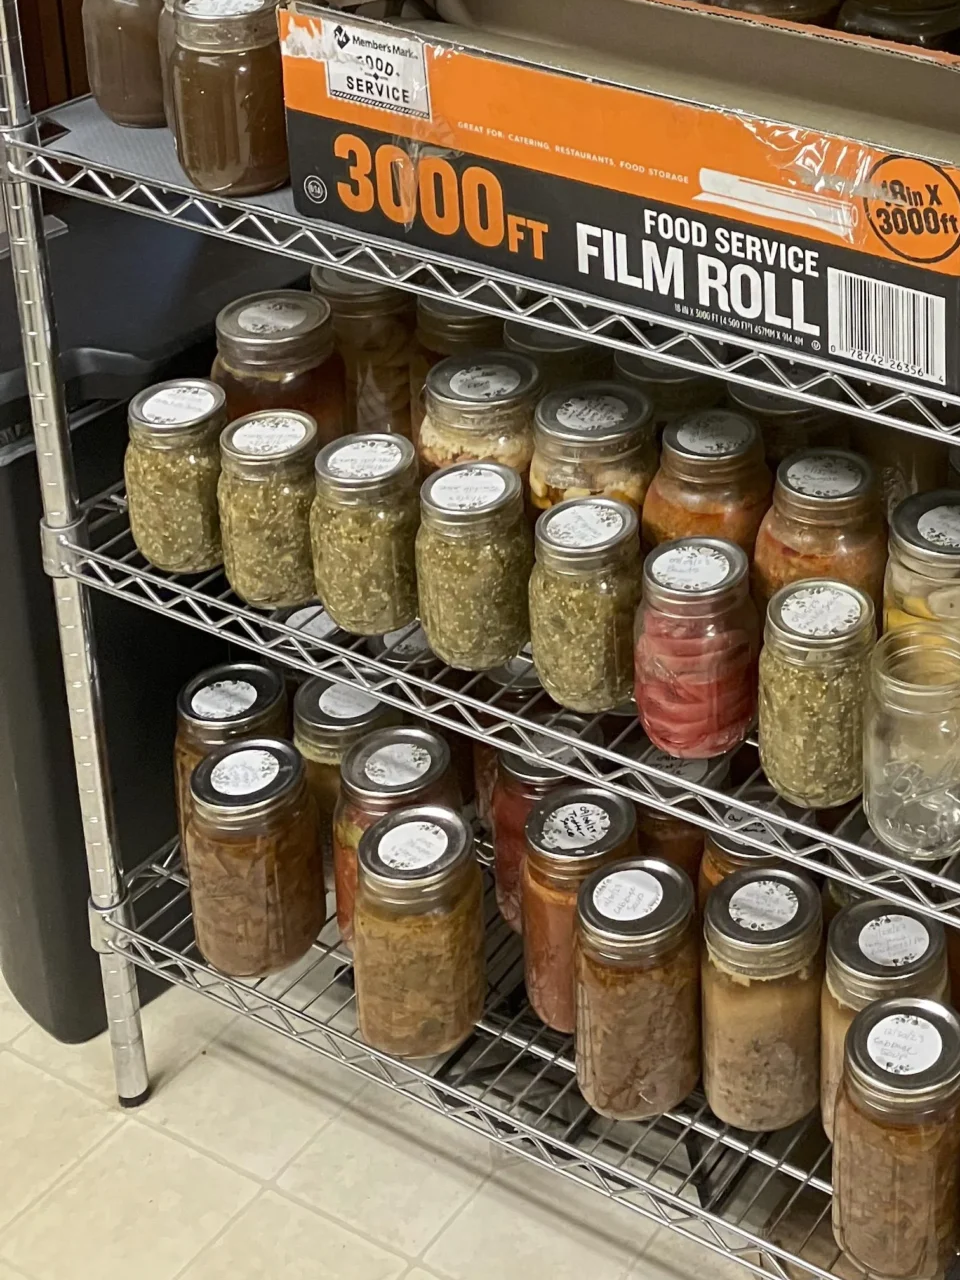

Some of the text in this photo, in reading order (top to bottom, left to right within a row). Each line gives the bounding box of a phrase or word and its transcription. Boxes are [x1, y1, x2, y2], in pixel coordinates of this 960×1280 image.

[352, 35, 414, 60] Member's Mark
[346, 75, 410, 104] SERVICE
[457, 120, 484, 134] GREAT
[554, 144, 617, 168] RESTAURANTS,
[619, 160, 646, 174] FOOD
[648, 167, 689, 185] STORAGE
[643, 208, 820, 278] FOOD SERVICE
[576, 221, 821, 337] FILM ROLL
[850, 348, 884, 366] 78742
[889, 359, 925, 378] 26356
